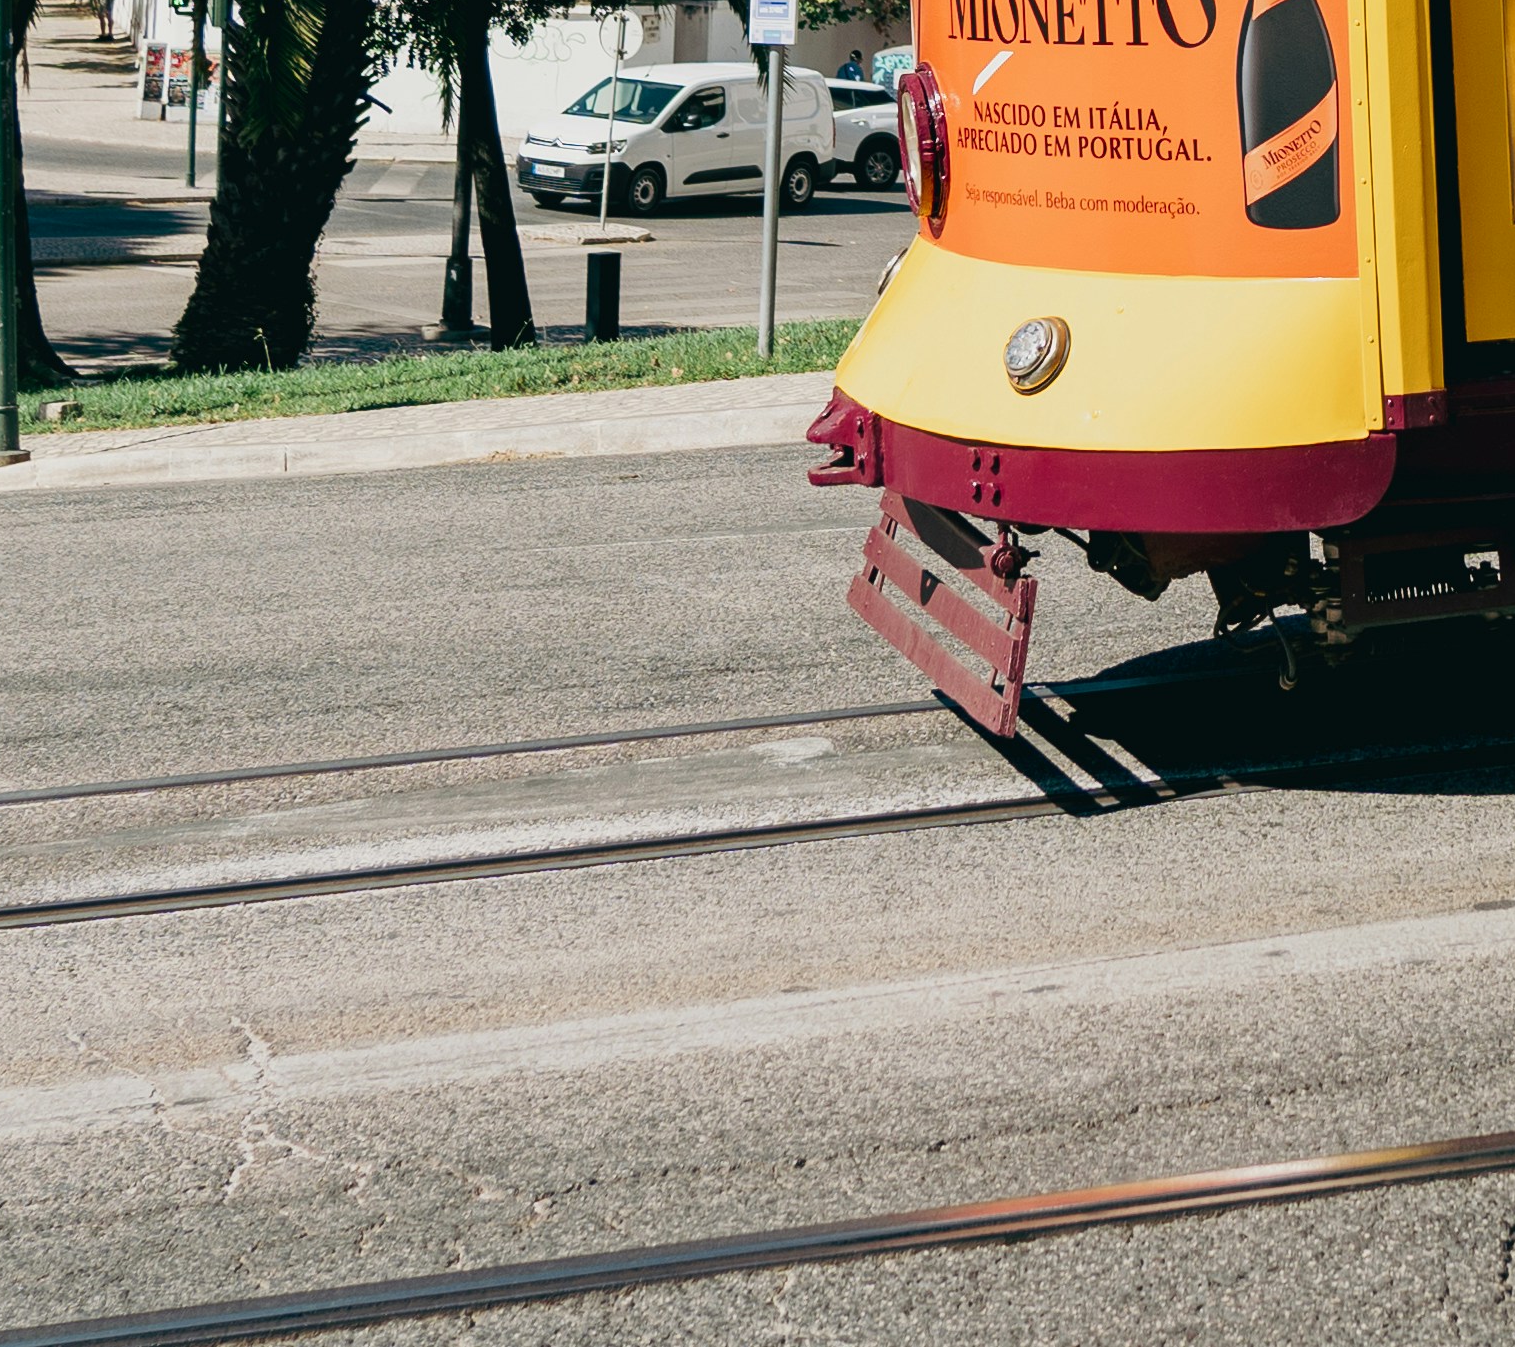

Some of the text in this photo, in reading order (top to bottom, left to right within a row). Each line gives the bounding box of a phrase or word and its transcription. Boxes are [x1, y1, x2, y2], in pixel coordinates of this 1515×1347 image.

[974, 100, 1168, 135] NASCIDO EM ITÁLIA,
[957, 127, 1212, 162] APRECIADO EM PORTUGAL.
[965, 182, 1201, 219] Seja responsável. Beba com moderação.
